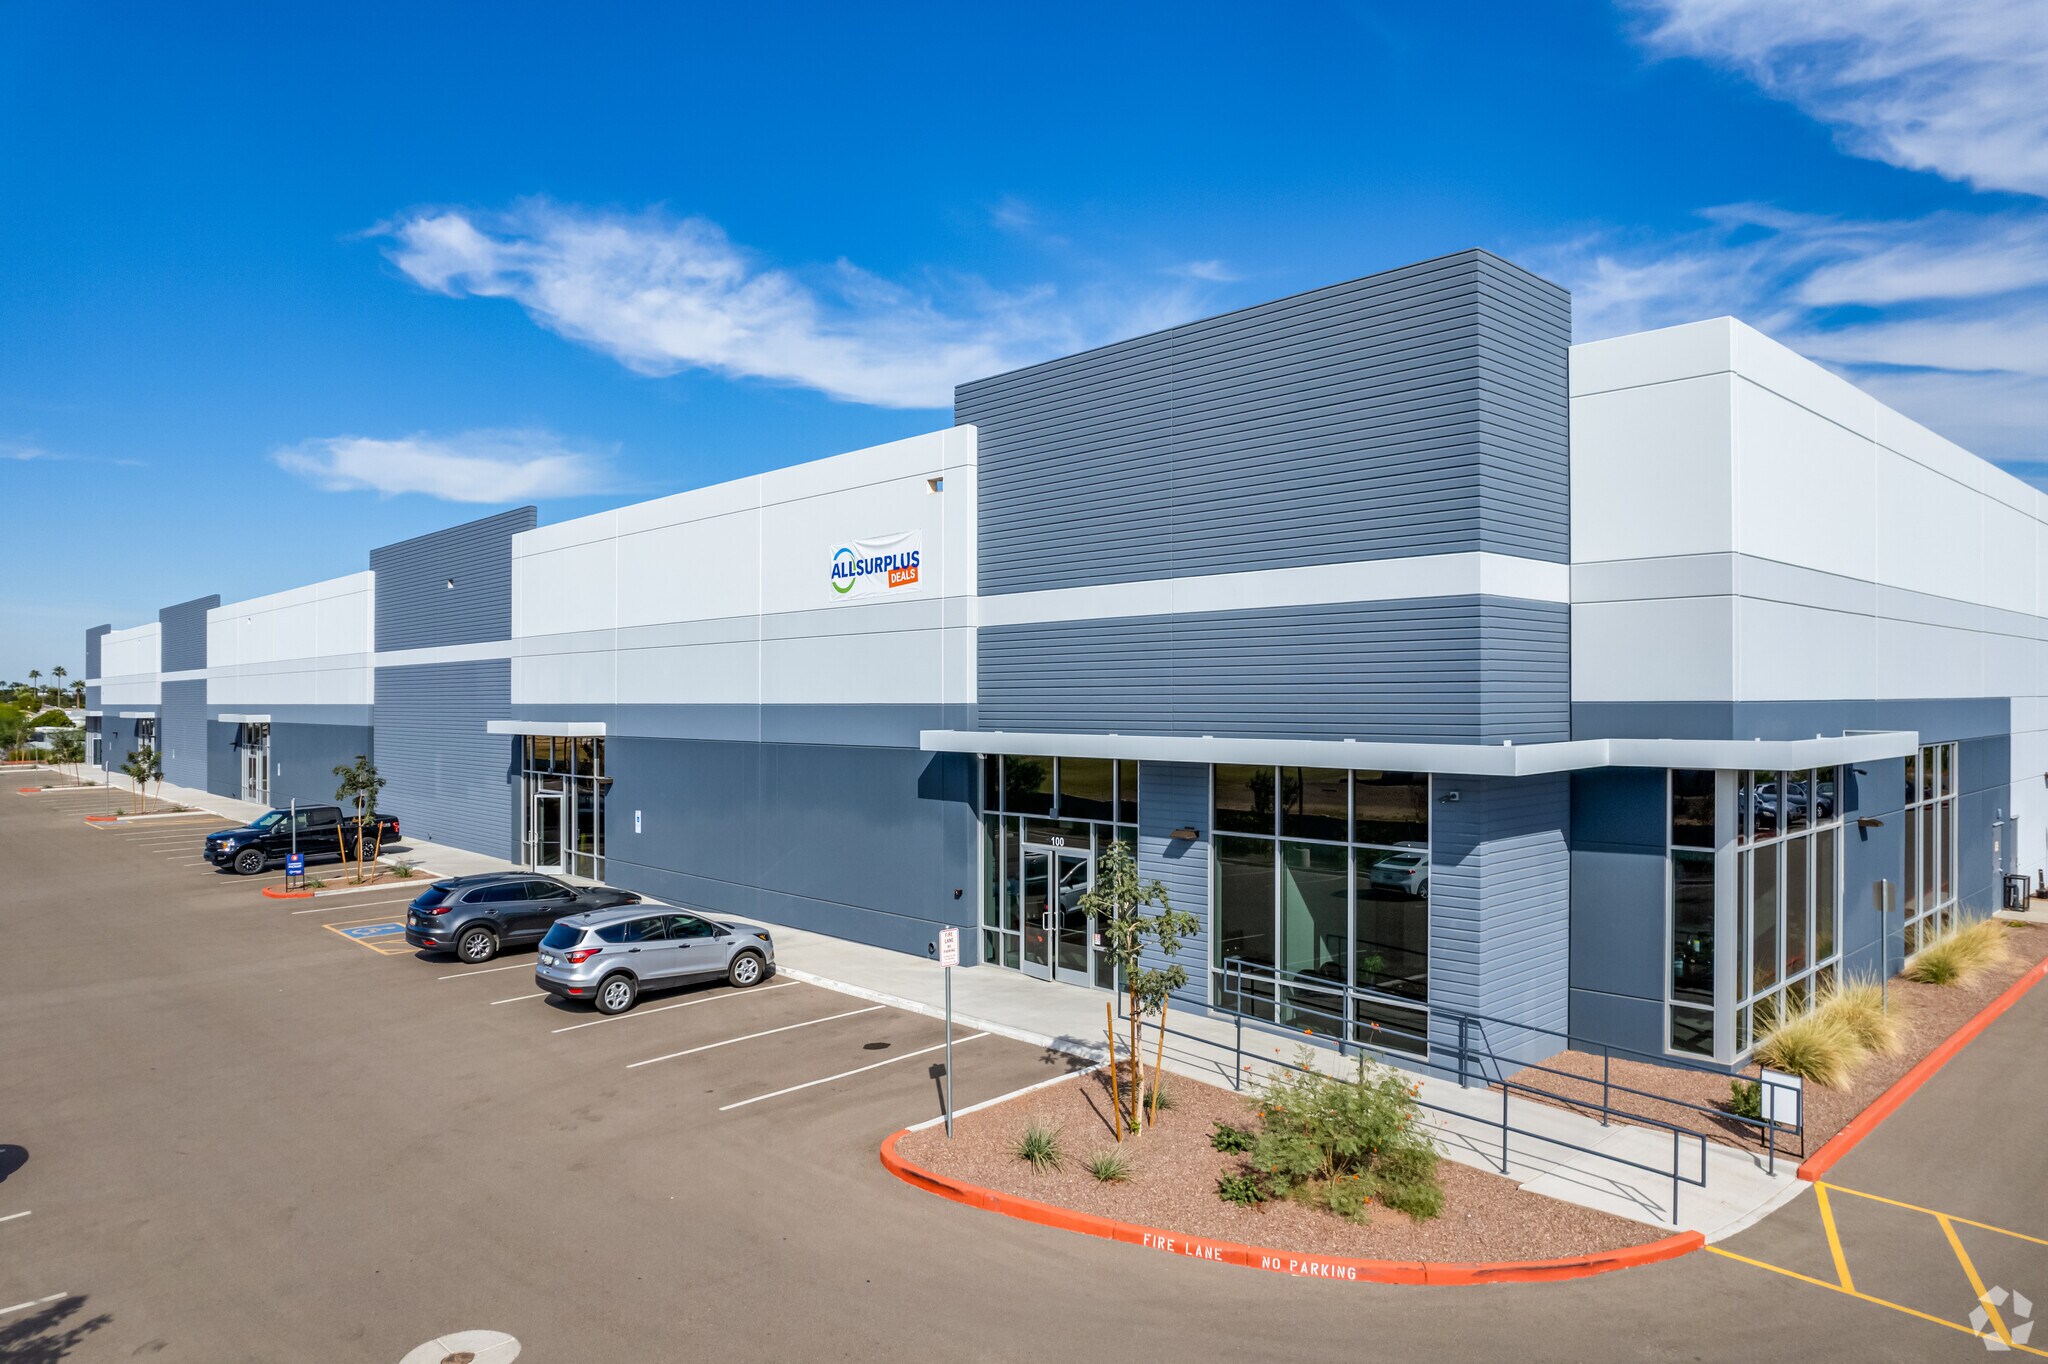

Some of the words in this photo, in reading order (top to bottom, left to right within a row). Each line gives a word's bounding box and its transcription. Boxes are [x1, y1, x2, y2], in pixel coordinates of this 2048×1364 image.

[831, 550, 920, 579] ALLSURPLUS
[890, 568, 916, 583] DEALS
[1051, 836, 1064, 846] 100
[1143, 1233, 1175, 1252] FIRE
[1185, 1242, 1223, 1261] LANE
[1262, 1256, 1281, 1270] NO
[1289, 1260, 1357, 1280] PARKING
